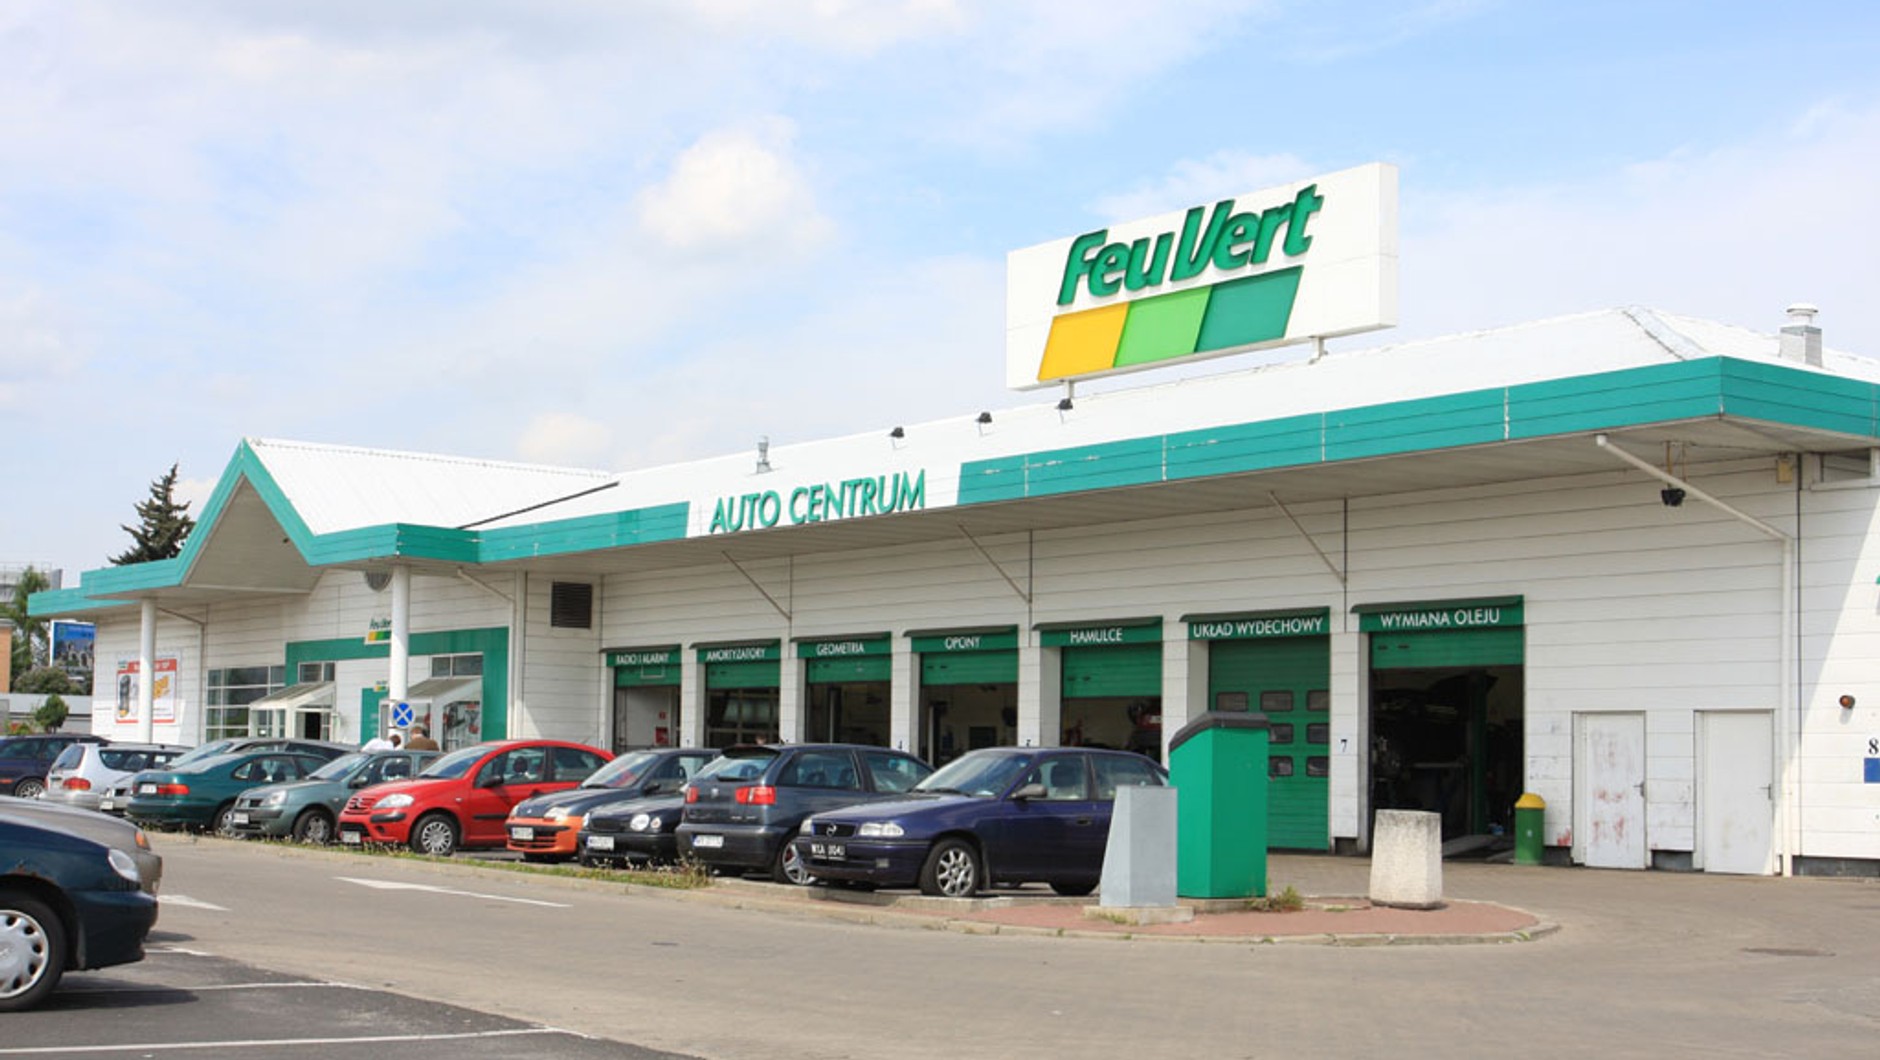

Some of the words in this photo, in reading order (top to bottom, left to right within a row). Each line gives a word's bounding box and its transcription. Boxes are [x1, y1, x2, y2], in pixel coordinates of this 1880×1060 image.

[709, 490, 782, 534] AUTO
[788, 468, 926, 525] CENTRUM
[1380, 612, 1451, 628] WYMIANA
[1453, 608, 1501, 625] OLEJU
[1069, 627, 1124, 644] HAMULCE
[1192, 622, 1234, 639] UKŁAD
[1236, 617, 1323, 636] WYDECHOWY
[816, 640, 866, 656] GEOMETRIA
[944, 635, 982, 650] OPONY
[706, 648, 766, 662] AMORTYZATORY
[1340, 738, 1348, 753] 7
